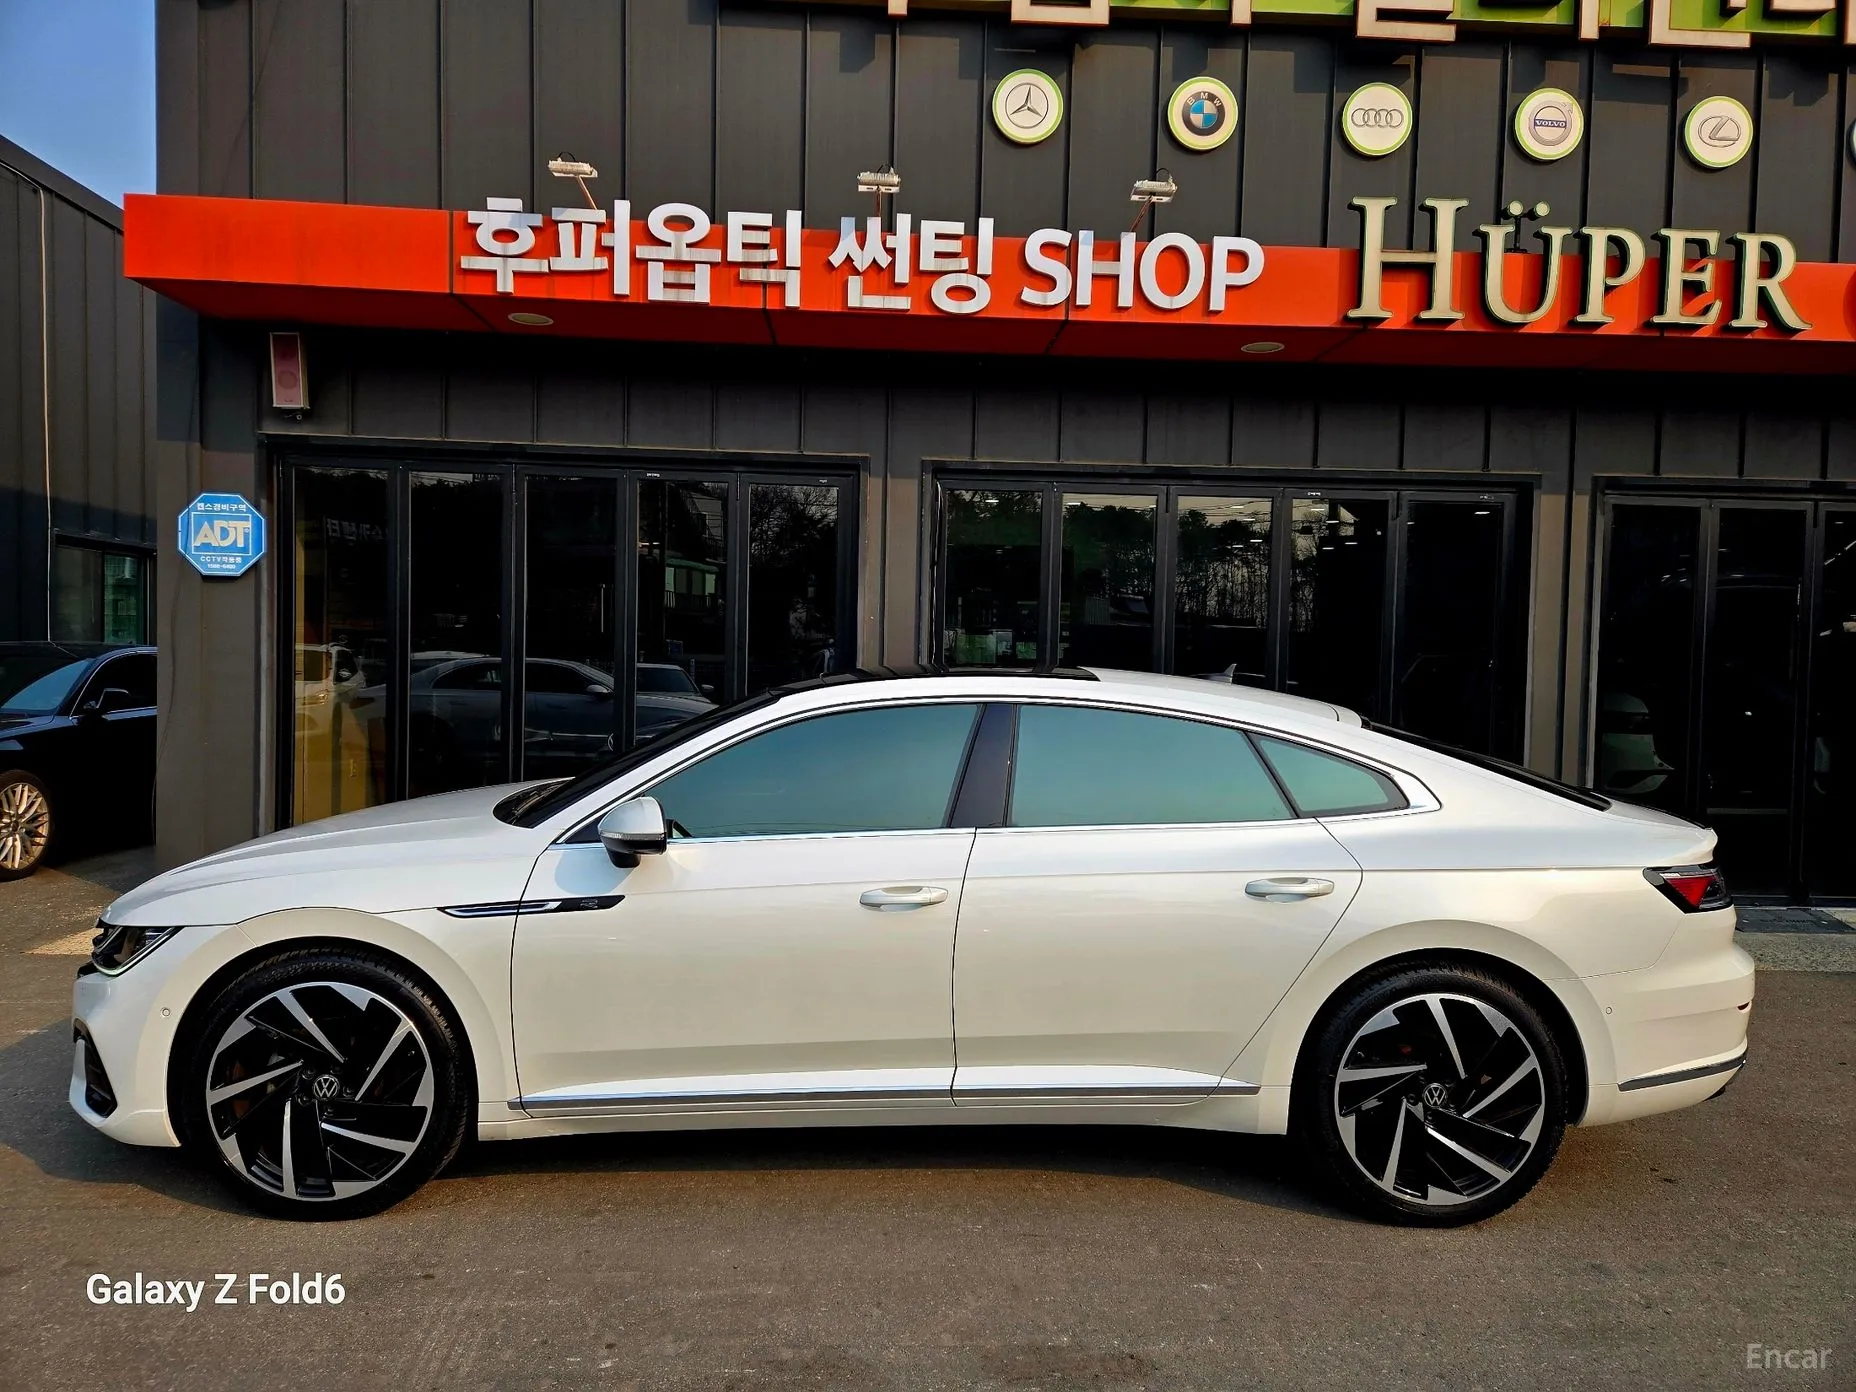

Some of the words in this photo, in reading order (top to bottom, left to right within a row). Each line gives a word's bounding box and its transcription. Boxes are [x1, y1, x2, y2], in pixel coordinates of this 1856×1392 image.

[1187, 92, 1222, 107] BMW
[460, 197, 803, 307] 후퍼옵틱
[828, 213, 994, 314] 썬팅
[1020, 228, 1265, 312] SHOP
[1346, 196, 1813, 330] HÜPER
[193, 520, 250, 547] ADT
